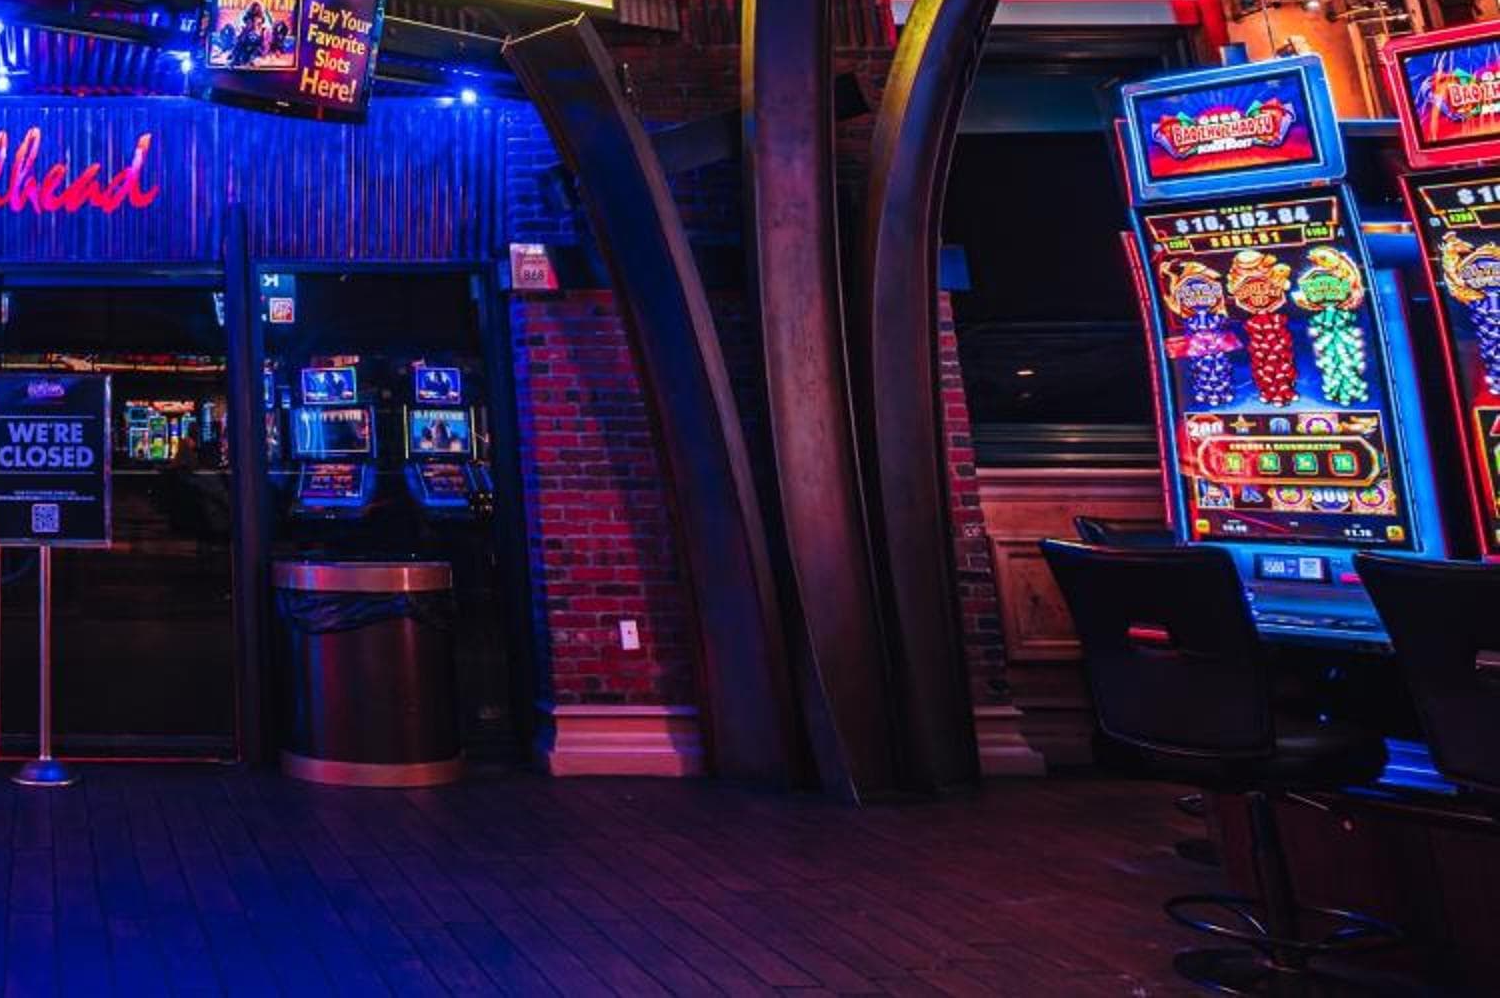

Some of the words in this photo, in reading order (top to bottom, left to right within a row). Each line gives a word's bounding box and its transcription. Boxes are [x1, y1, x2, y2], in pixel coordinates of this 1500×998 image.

[308, 1, 339, 30] Play
[340, 9, 373, 35] Your
[307, 25, 366, 56] Favorite
[315, 50, 352, 74] Slots
[300, 68, 358, 103] Here!
[7, 422, 84, 443] WE'RE
